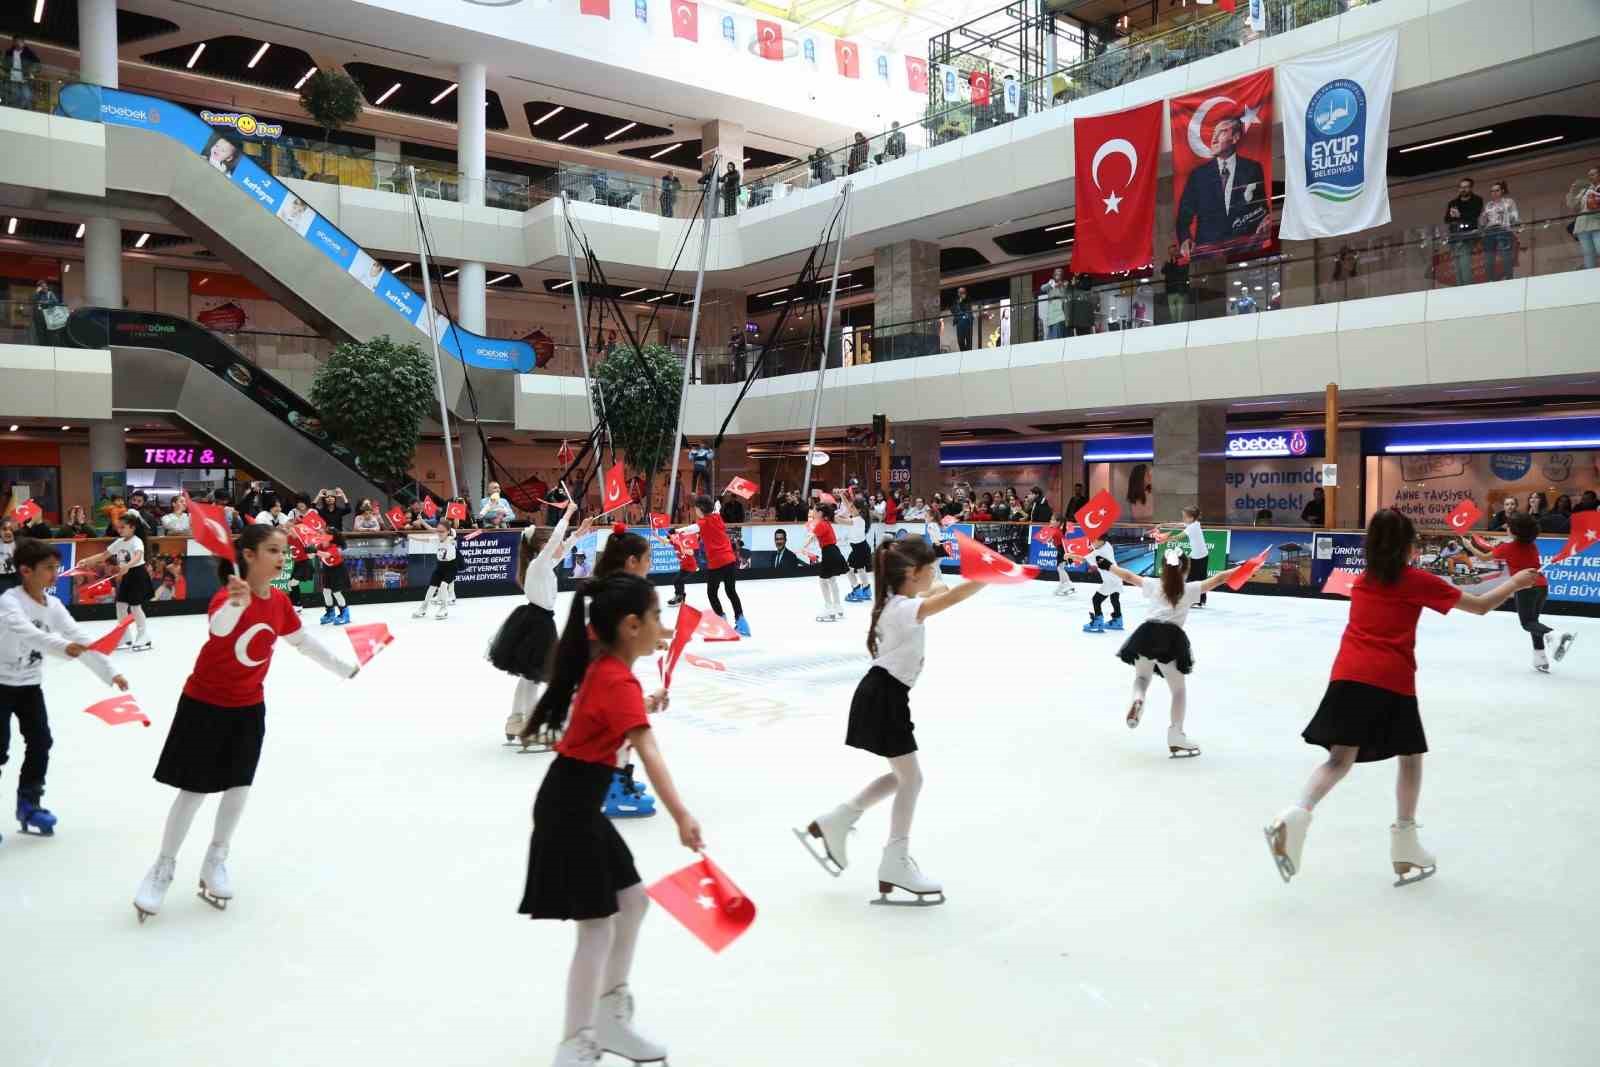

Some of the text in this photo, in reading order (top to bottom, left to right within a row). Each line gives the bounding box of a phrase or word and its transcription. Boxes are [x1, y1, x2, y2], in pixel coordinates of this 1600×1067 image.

[101, 104, 147, 119] ebebek
[201, 111, 282, 138] Funny Day
[1312, 134, 1359, 158] EYÜP
[1311, 151, 1358, 171] SULTAN
[1229, 436, 1287, 450] ebebek
[199, 449, 214, 464] &
[1225, 470, 1245, 487] ep
[1235, 494, 1303, 510] ebebek!
[1395, 490, 1420, 500] ANNE
